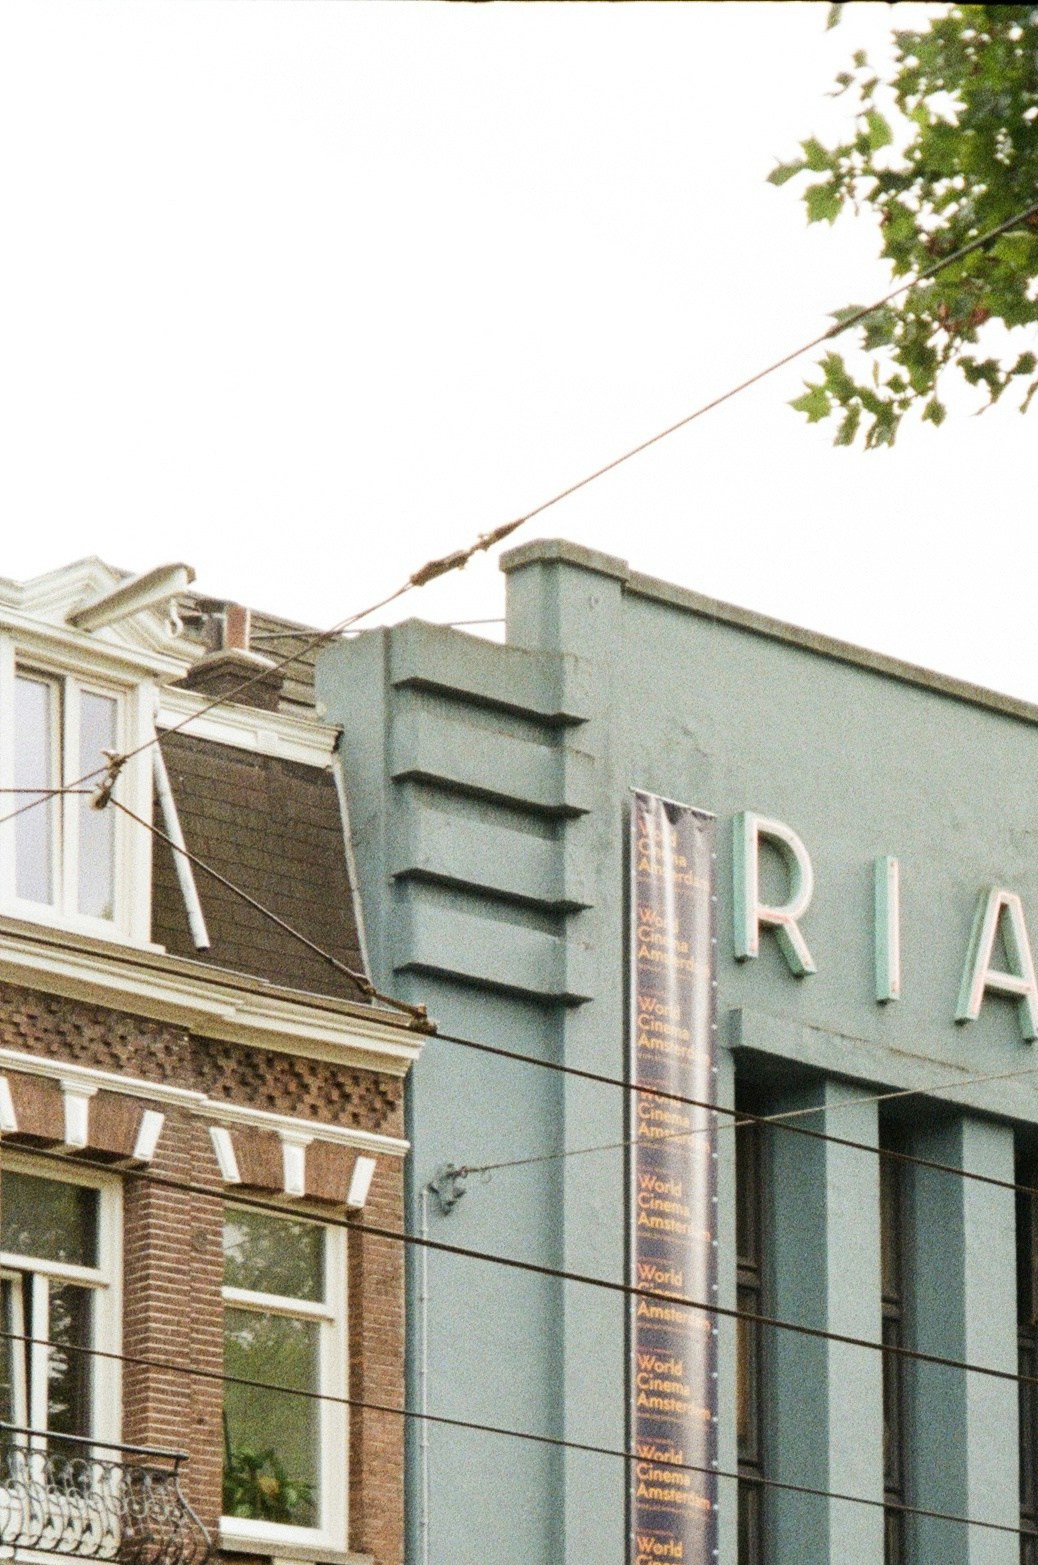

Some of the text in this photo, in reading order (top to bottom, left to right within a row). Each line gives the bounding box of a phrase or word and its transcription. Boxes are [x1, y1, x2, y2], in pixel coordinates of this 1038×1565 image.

[638, 1174, 681, 1197] World
[638, 1192, 689, 1218] Cinema
[637, 1263, 682, 1286] World
[636, 1354, 682, 1376] World
[636, 1372, 690, 1396] Cinema
[636, 1463, 690, 1486] Cinema
[636, 1536, 683, 1558] World
